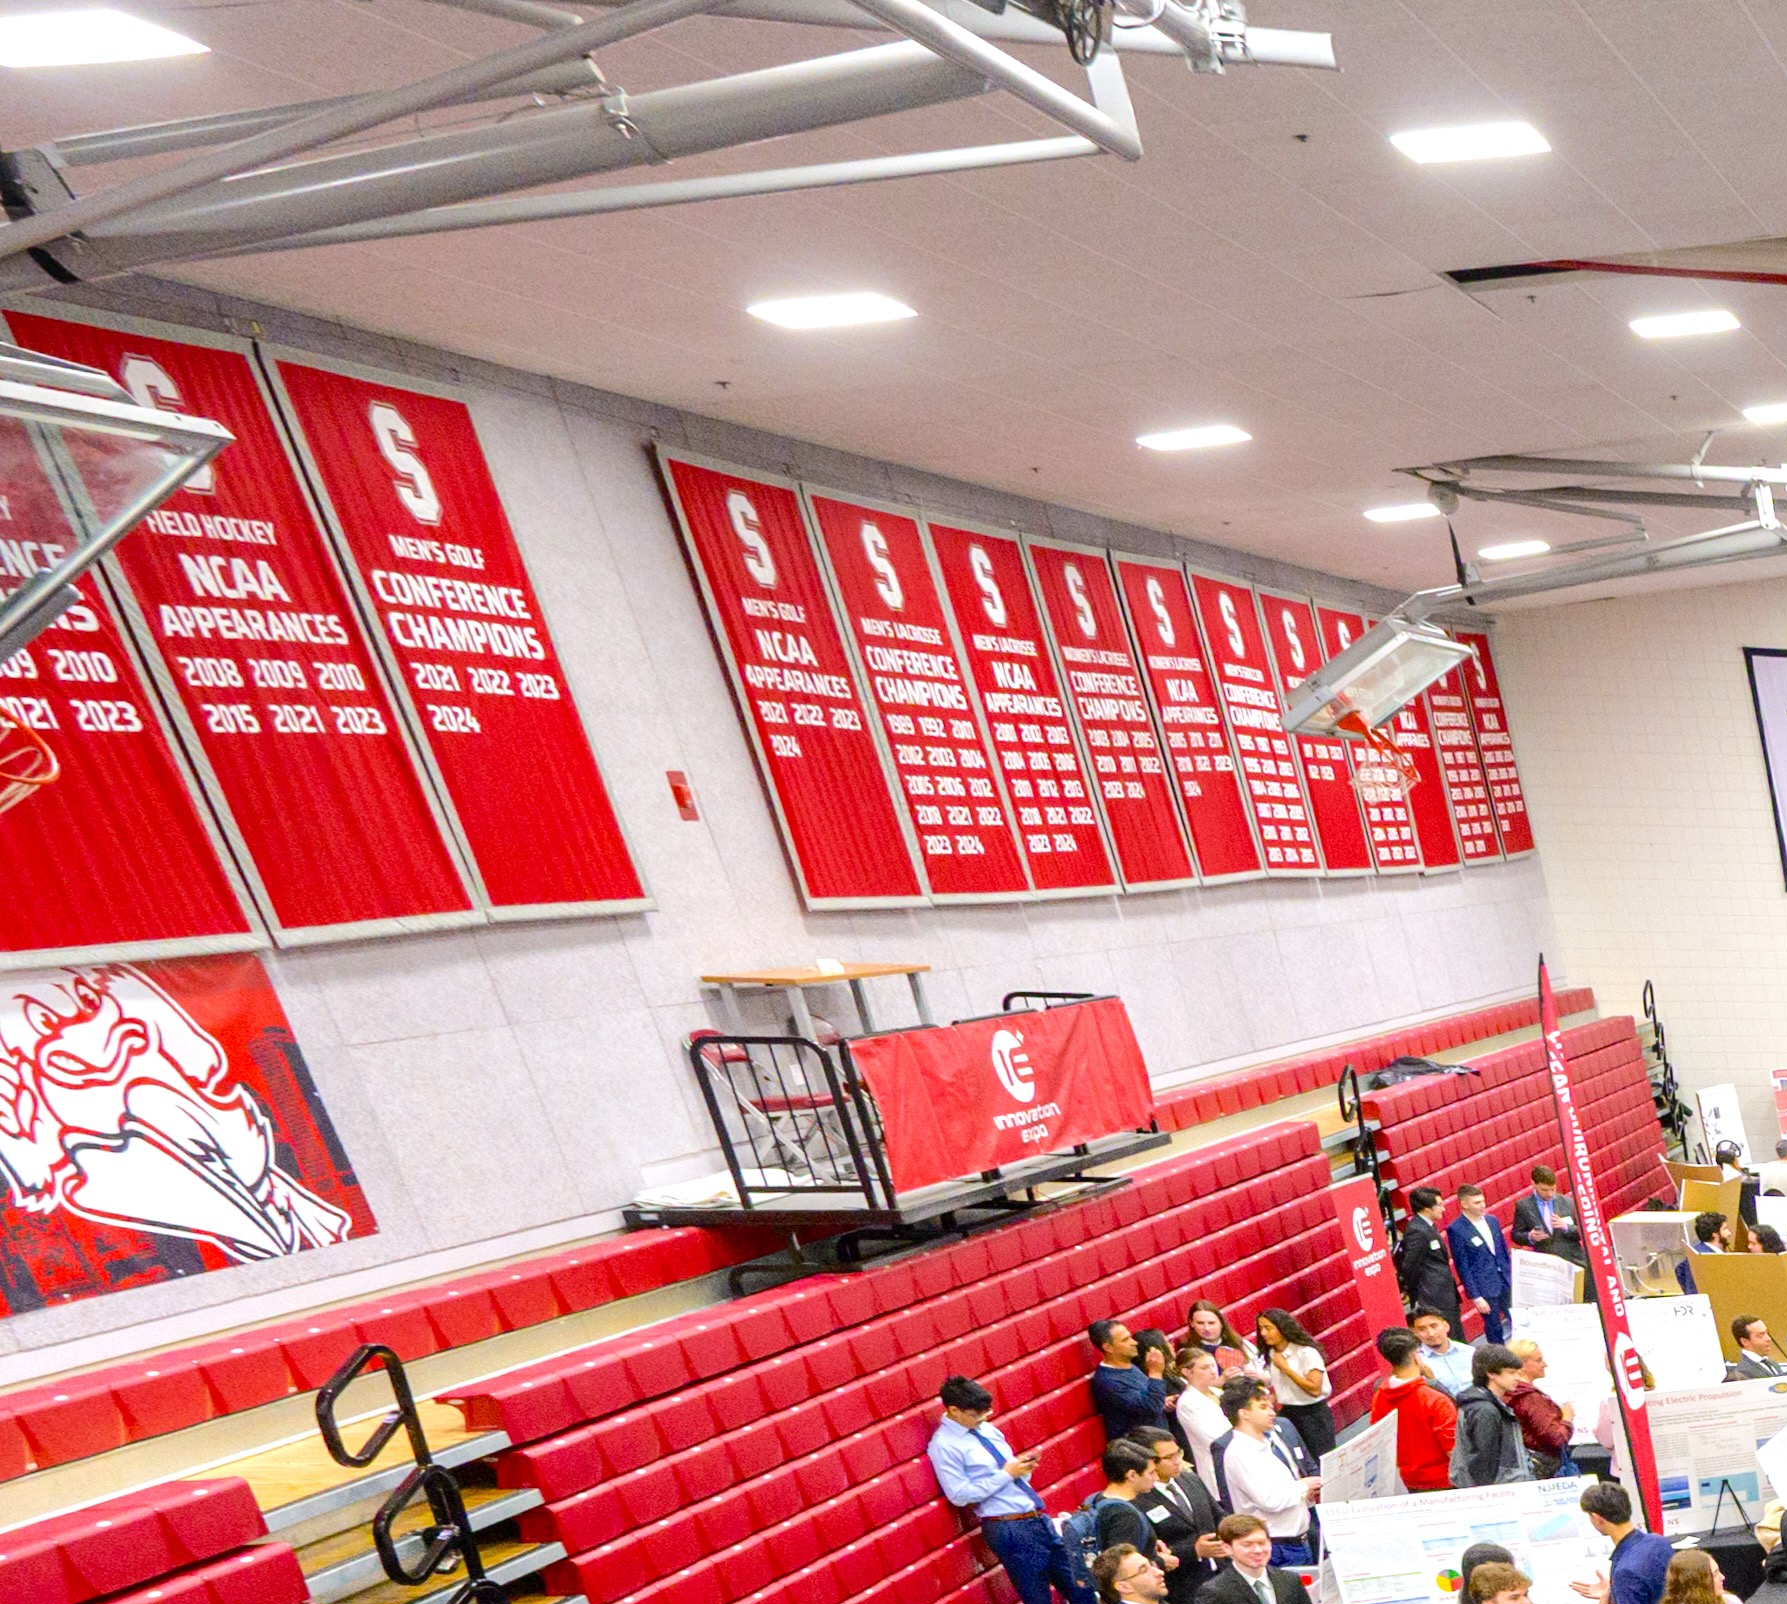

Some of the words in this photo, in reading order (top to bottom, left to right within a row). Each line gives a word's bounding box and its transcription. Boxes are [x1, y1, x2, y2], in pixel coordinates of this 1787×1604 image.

[200, 514, 276, 545] HOCKEY
[389, 535, 446, 563] MEN'S
[445, 543, 484, 569] GOLF
[179, 554, 291, 602] NCAA
[372, 569, 531, 619] CONFERENCE
[160, 605, 348, 645] APPEARANCES
[742, 598, 779, 618] MEN'S
[778, 603, 805, 623] GOLF
[389, 612, 544, 660] CHAMPIONS
[756, 629, 818, 666] NCAA
[177, 657, 244, 687] 2008
[248, 659, 307, 689] 2009
[313, 662, 365, 691] 2010
[410, 663, 461, 691] 2021
[467, 667, 514, 695] 2022
[516, 672, 560, 700] 2023
[746, 665, 851, 699] APPEARANCES
[202, 704, 261, 733] 2015
[268, 705, 325, 733] 2021
[330, 706, 387, 734] 2023
[427, 704, 480, 733] 2024
[757, 701, 789, 723] 2021
[791, 704, 826, 726] 2022
[829, 708, 861, 730] 2023
[770, 735, 802, 757] 2024
[993, 1103, 1061, 1130] innovation
[1021, 1123, 1049, 1144] expo
